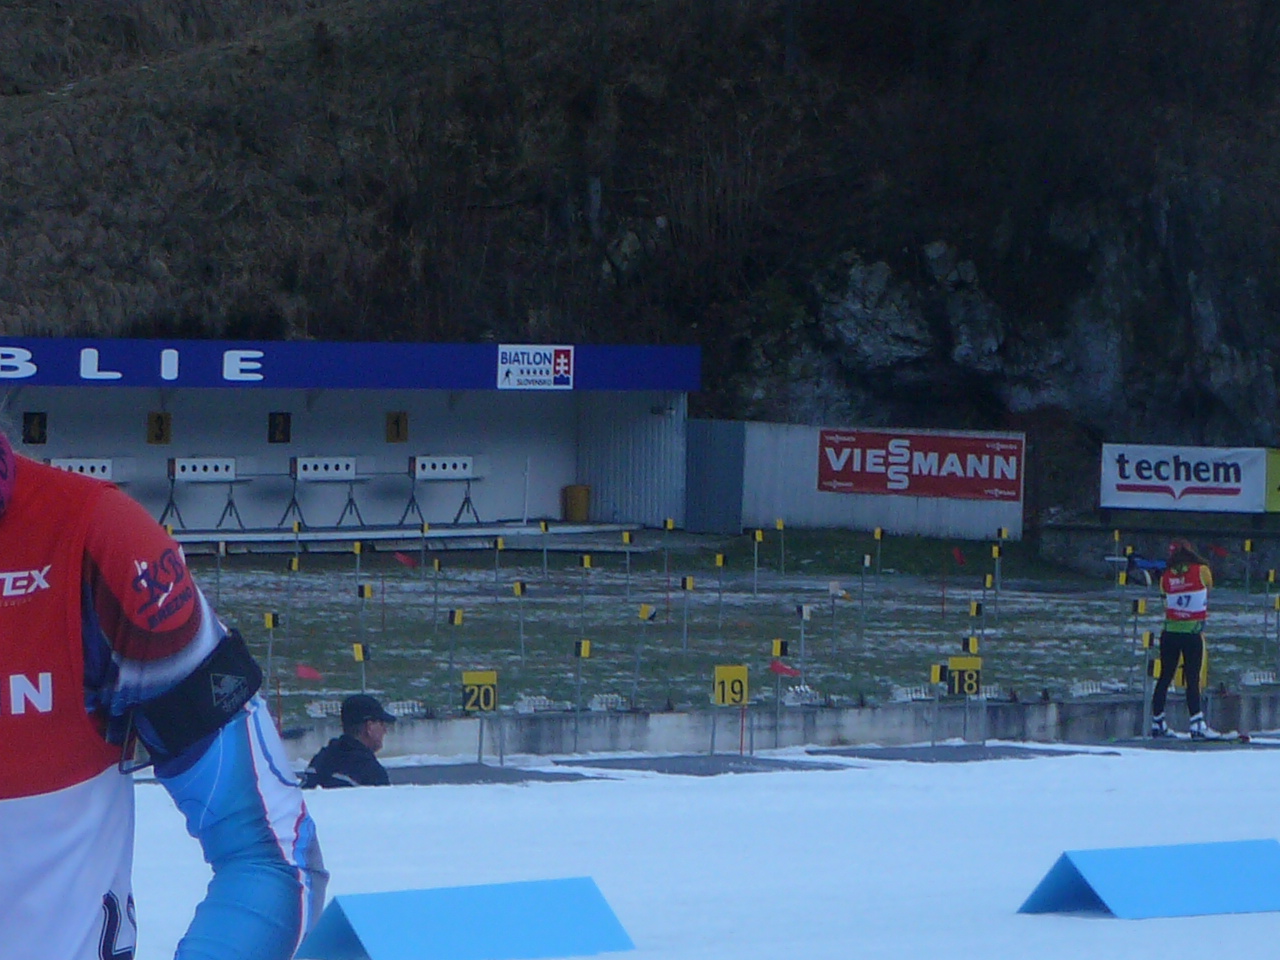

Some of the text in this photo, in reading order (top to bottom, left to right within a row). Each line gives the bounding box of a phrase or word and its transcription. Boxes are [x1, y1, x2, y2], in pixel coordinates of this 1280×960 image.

[500, 351, 553, 366] BIATLON
[154, 414, 165, 441] 3
[393, 415, 402, 440] 1
[824, 438, 1018, 490] VIESSMANN
[1115, 453, 1242, 483] techem
[1176, 594, 1192, 608] 47
[718, 678, 745, 704] 19
[950, 670, 978, 694] 18
[464, 685, 495, 712] 20
